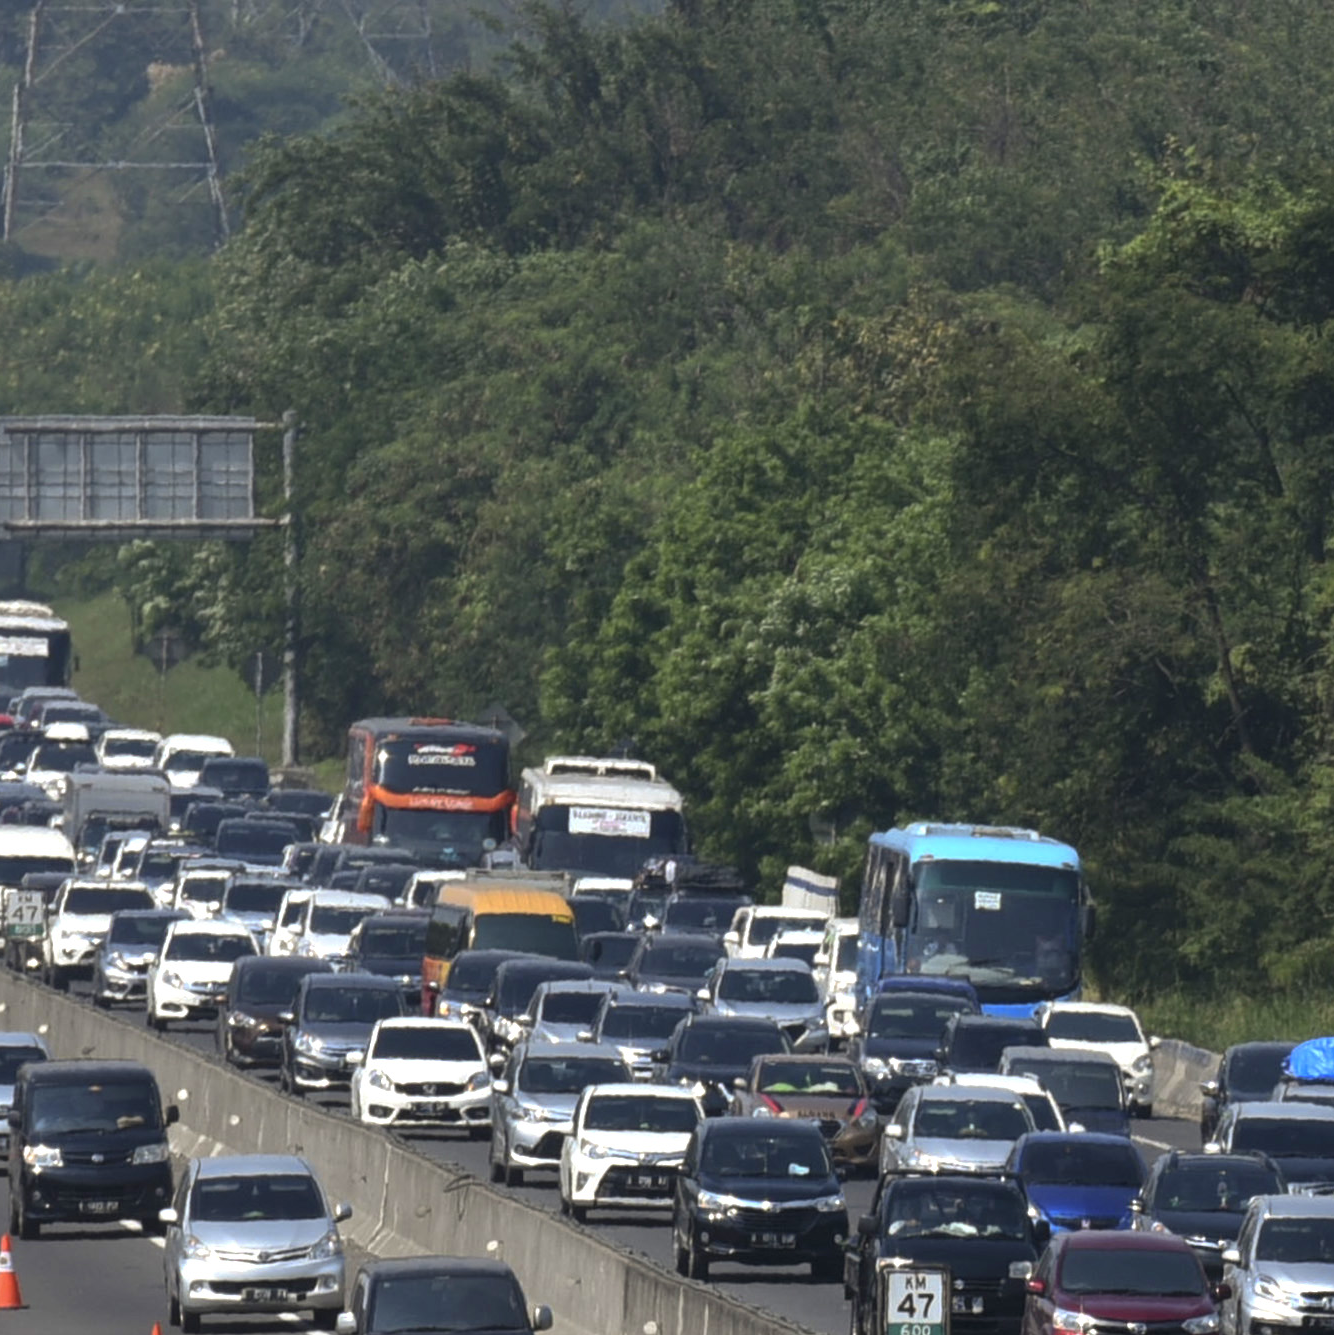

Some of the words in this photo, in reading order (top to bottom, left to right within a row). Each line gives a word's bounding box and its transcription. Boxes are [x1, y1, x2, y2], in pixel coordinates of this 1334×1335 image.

[11, 905, 39, 922] 47
[905, 1276, 927, 1290] KM
[896, 1292, 935, 1318] 47
